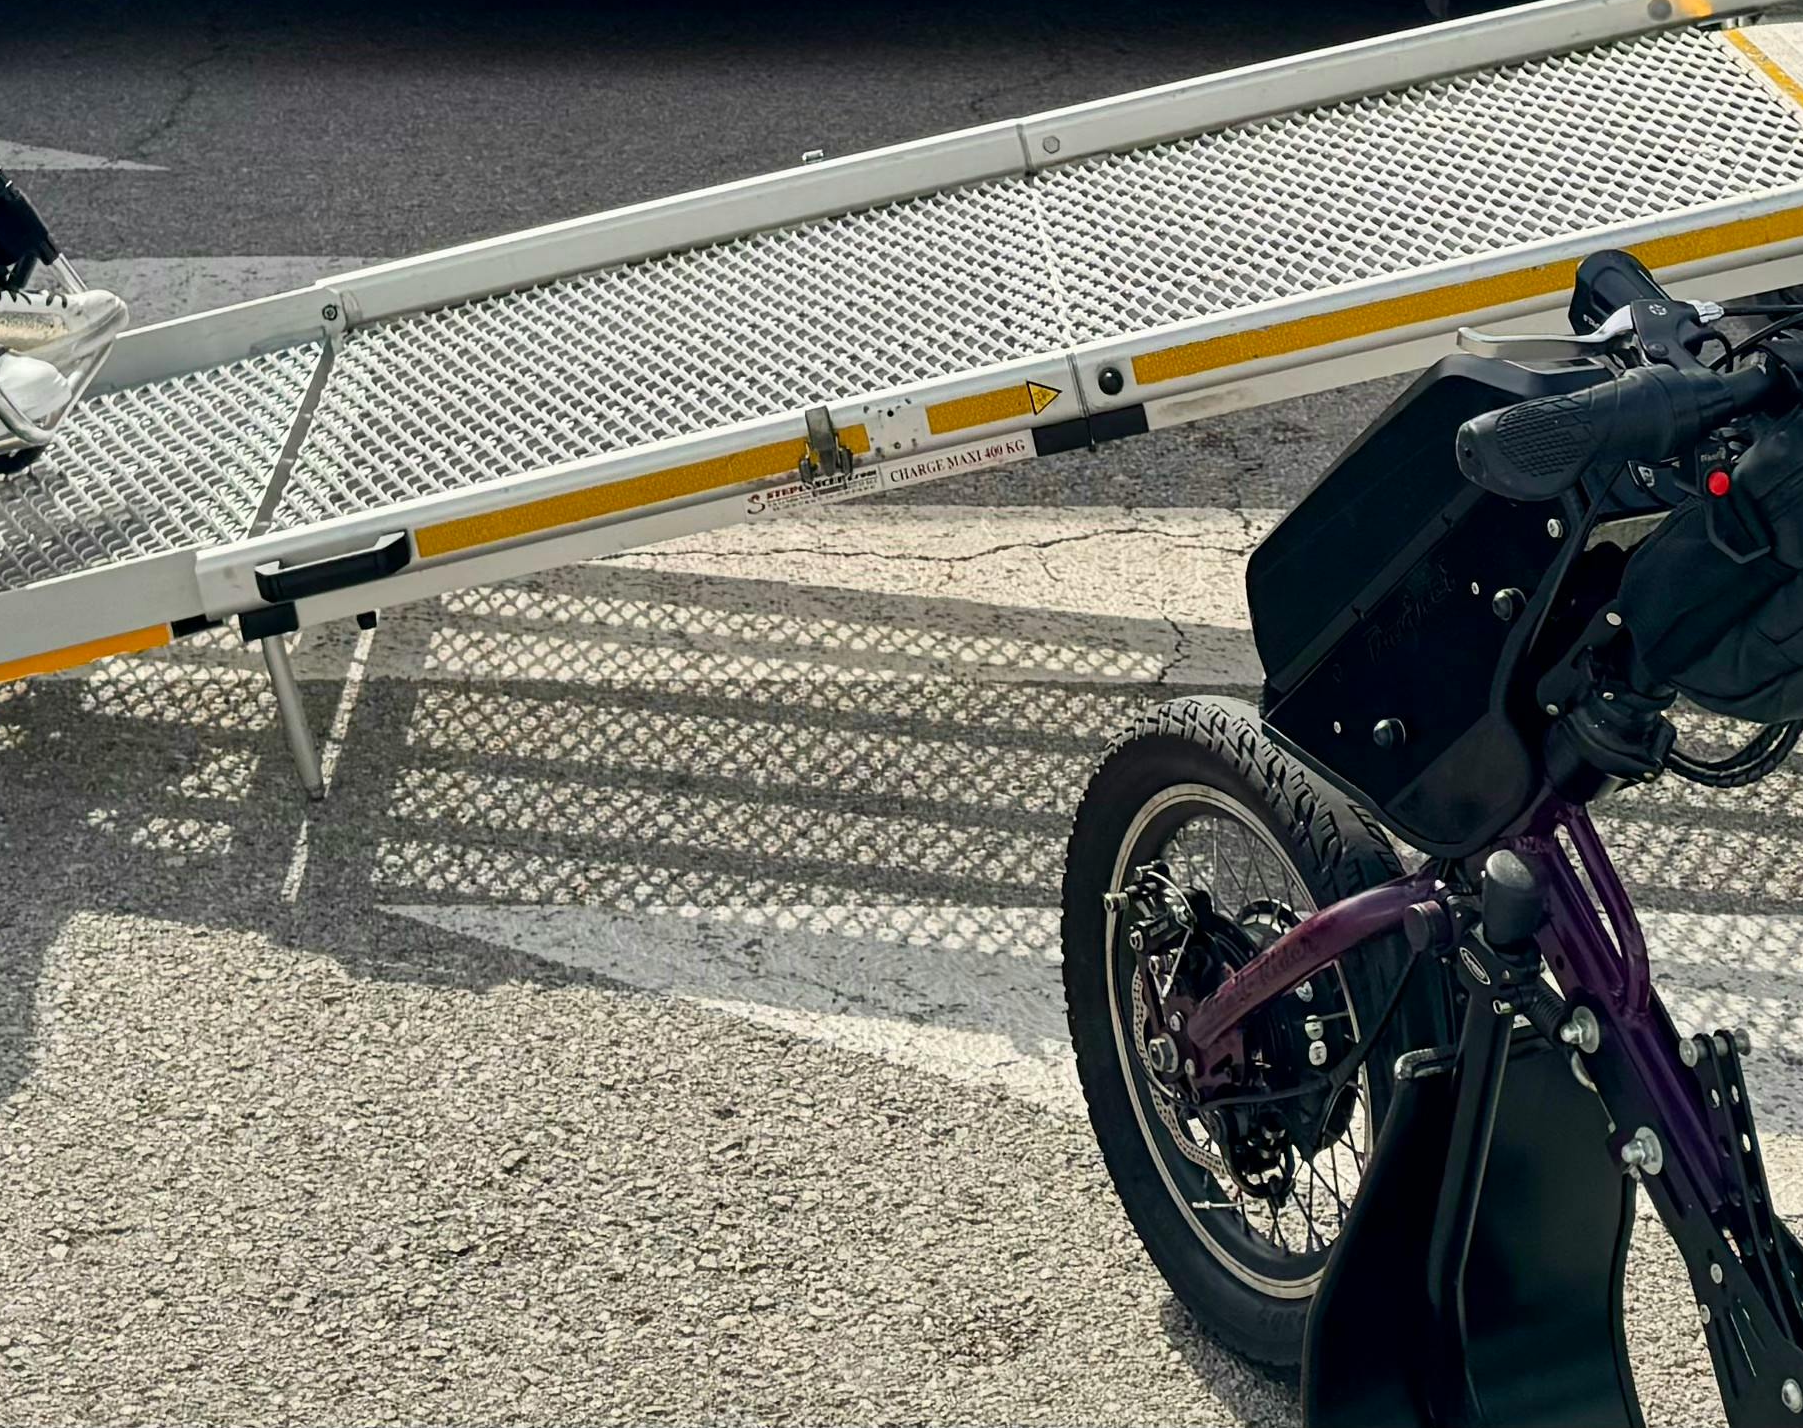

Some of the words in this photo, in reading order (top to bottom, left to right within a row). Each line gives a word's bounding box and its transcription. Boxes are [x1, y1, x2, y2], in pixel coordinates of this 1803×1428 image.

[890, 458, 946, 483] CHARGE
[946, 449, 982, 470] MAXI
[983, 445, 1004, 459] 400
[1005, 438, 1026, 455] KG
